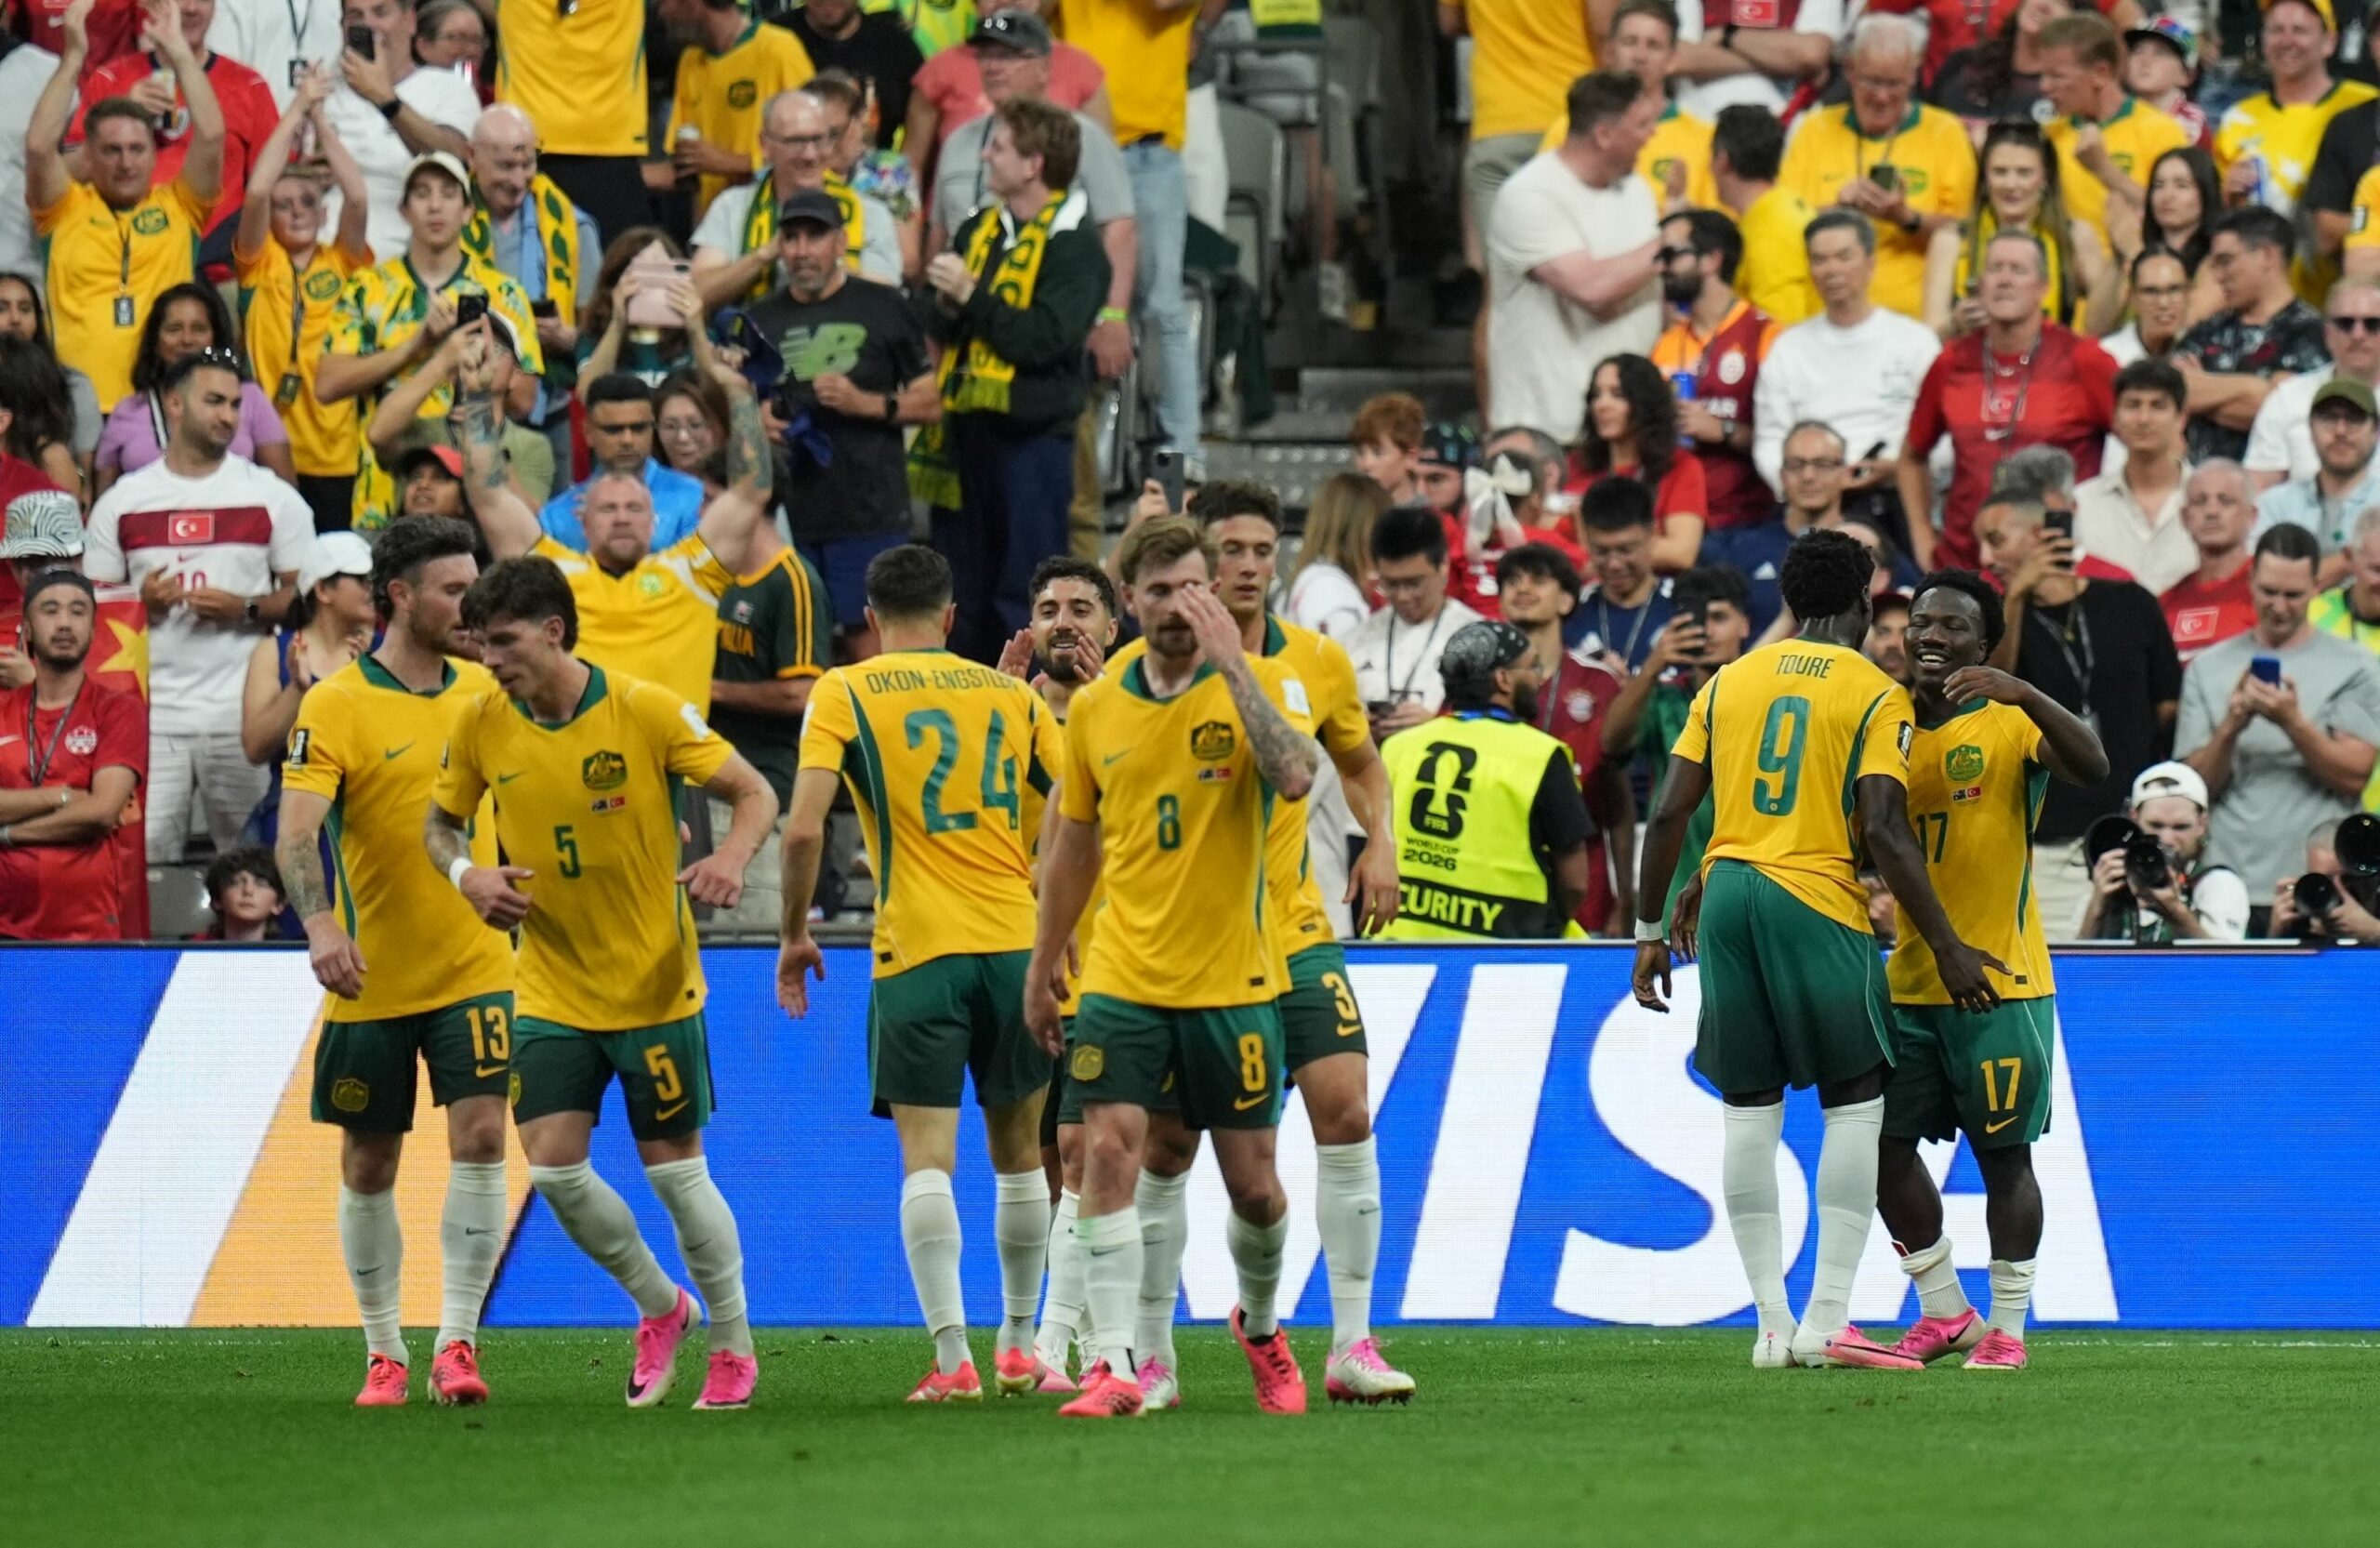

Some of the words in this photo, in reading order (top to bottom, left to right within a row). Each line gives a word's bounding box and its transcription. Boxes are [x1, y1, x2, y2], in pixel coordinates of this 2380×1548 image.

[1777, 655, 1834, 679] TOURE
[904, 708, 1020, 835] 24
[1752, 695, 1811, 816] 9
[1157, 794, 1182, 851] 8
[1407, 837, 1439, 851] WORLD
[1441, 845, 1460, 854] CUP
[1916, 812, 1949, 865] 17
[554, 825, 582, 879] 5
[1404, 848, 1457, 871] 2026
[1321, 972, 1358, 1021] 3
[467, 1006, 509, 1062] 13
[1238, 1032, 1266, 1092] 8
[644, 1043, 683, 1102] 5
[1980, 1056, 2022, 1112] 17
[1181, 963, 2119, 1325] VISA
